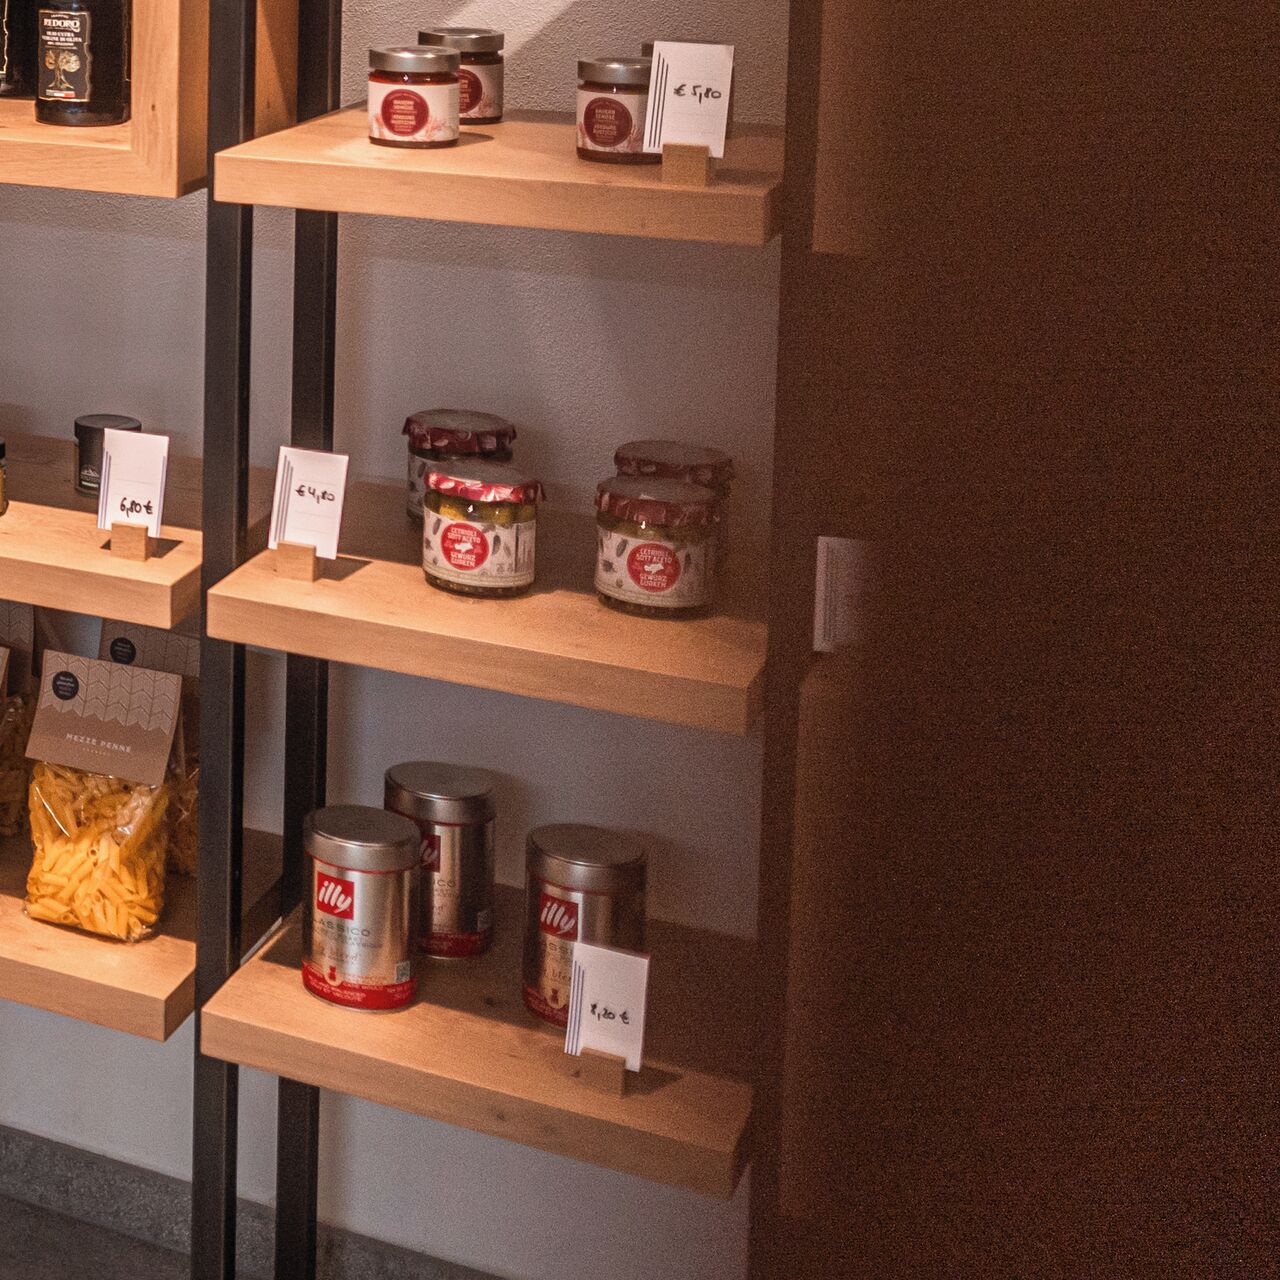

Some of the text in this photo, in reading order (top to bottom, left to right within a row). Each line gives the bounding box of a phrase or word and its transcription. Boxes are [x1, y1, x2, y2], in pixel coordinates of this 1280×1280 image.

[44, 19, 80, 32] REDORO
[674, 84, 722, 104] € 5,80
[120, 497, 153, 518] 6,80 €
[65, 733, 131, 753] MEZZE PENNE
[318, 880, 353, 914] illy
[540, 901, 576, 936] illy
